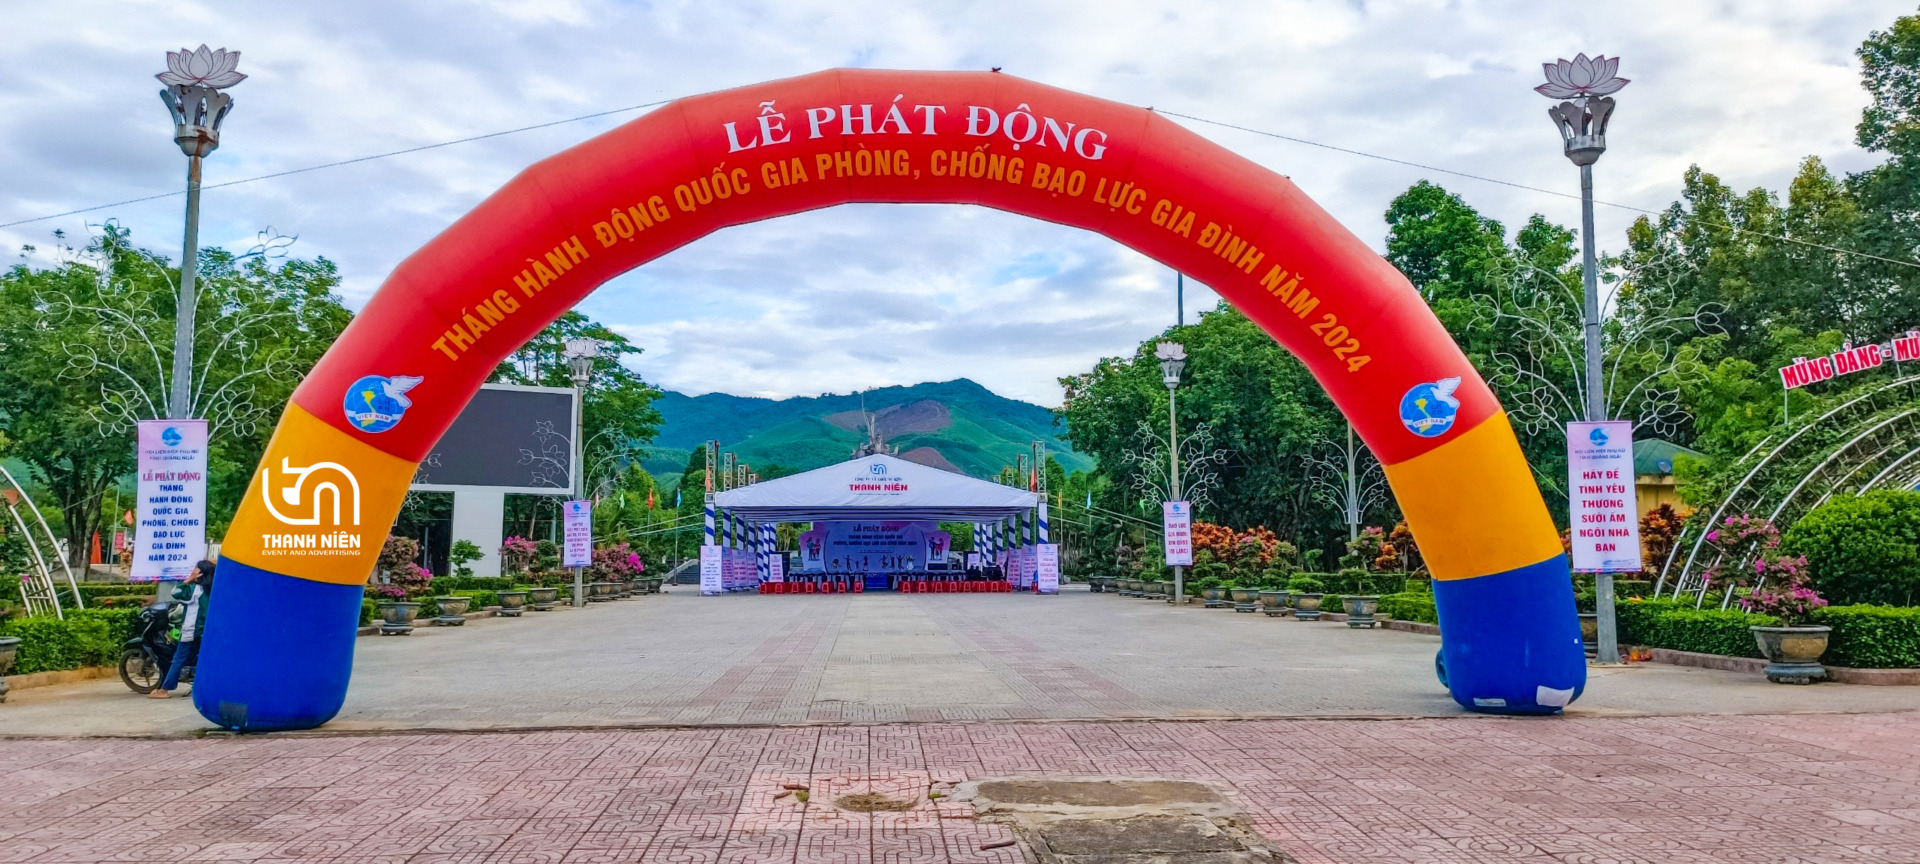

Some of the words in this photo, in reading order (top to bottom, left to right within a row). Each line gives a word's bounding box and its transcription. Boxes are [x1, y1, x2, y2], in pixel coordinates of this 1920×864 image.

[722, 99, 792, 153] LỄ
[806, 93, 947, 139] PHÁT
[964, 102, 1108, 160] ĐỘNG
[431, 288, 521, 362] THÁNG
[512, 235, 591, 298] HÀNH
[592, 195, 671, 249] ĐỘNG
[673, 161, 751, 213] QUỐC
[760, 157, 810, 189] GIA
[815, 143, 921, 180] PHÒNG,
[930, 143, 1025, 185] CHỐNG
[1031, 163, 1086, 198] BẠO
[1093, 176, 1147, 215] LỰC
[1150, 198, 1197, 239] GIA
[1196, 221, 1265, 274] ĐÌNH
[1259, 264, 1321, 319] NĂM
[1310, 313, 1372, 373] 2024
[1780, 357, 1833, 389] MỪNG
[1834, 342, 1882, 376] ĐẢNG
[1606, 482, 1625, 493] YÊU
[168, 553, 187, 561] 2024
